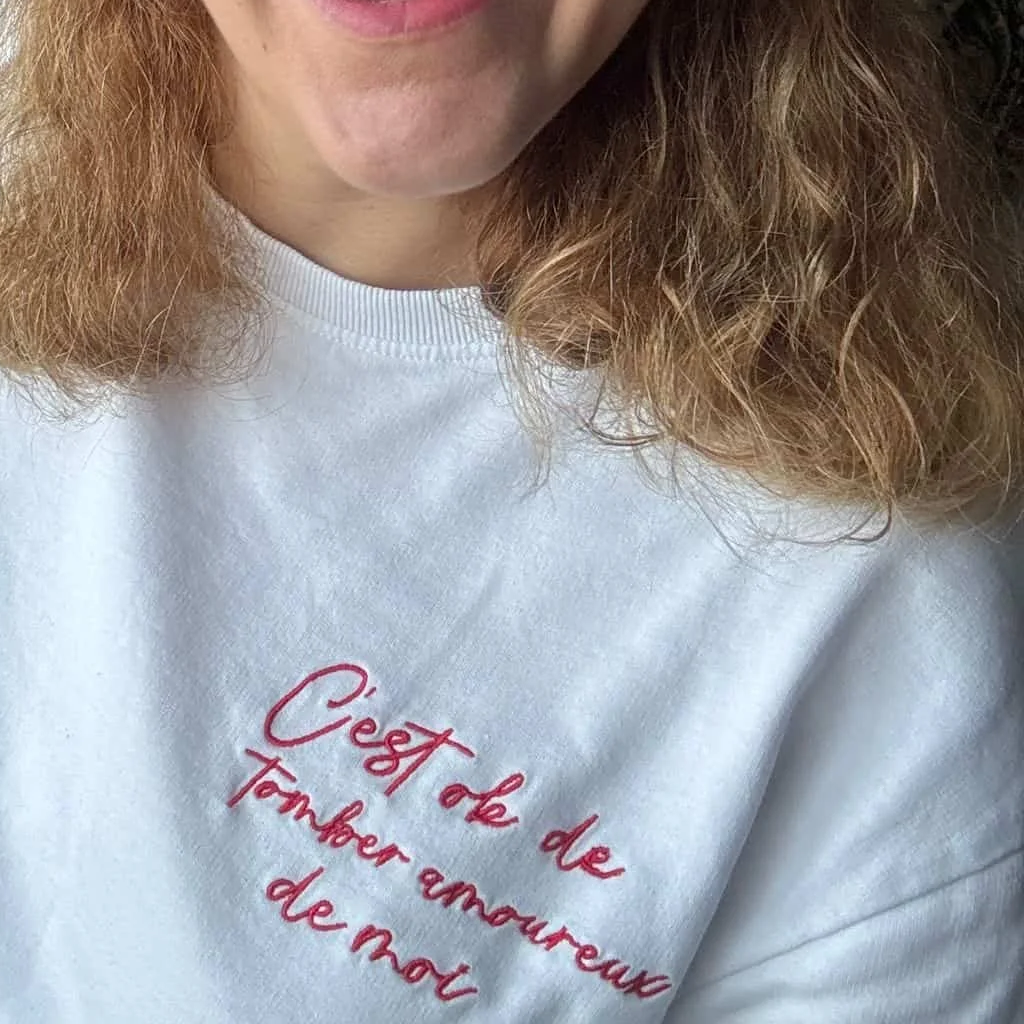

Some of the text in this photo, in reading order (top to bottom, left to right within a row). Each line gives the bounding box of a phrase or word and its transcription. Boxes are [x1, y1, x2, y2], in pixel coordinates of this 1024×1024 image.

[265, 663, 626, 879] C'est ok de
[266, 866, 478, 1002] de moi
[418, 867, 672, 997] amoureux
